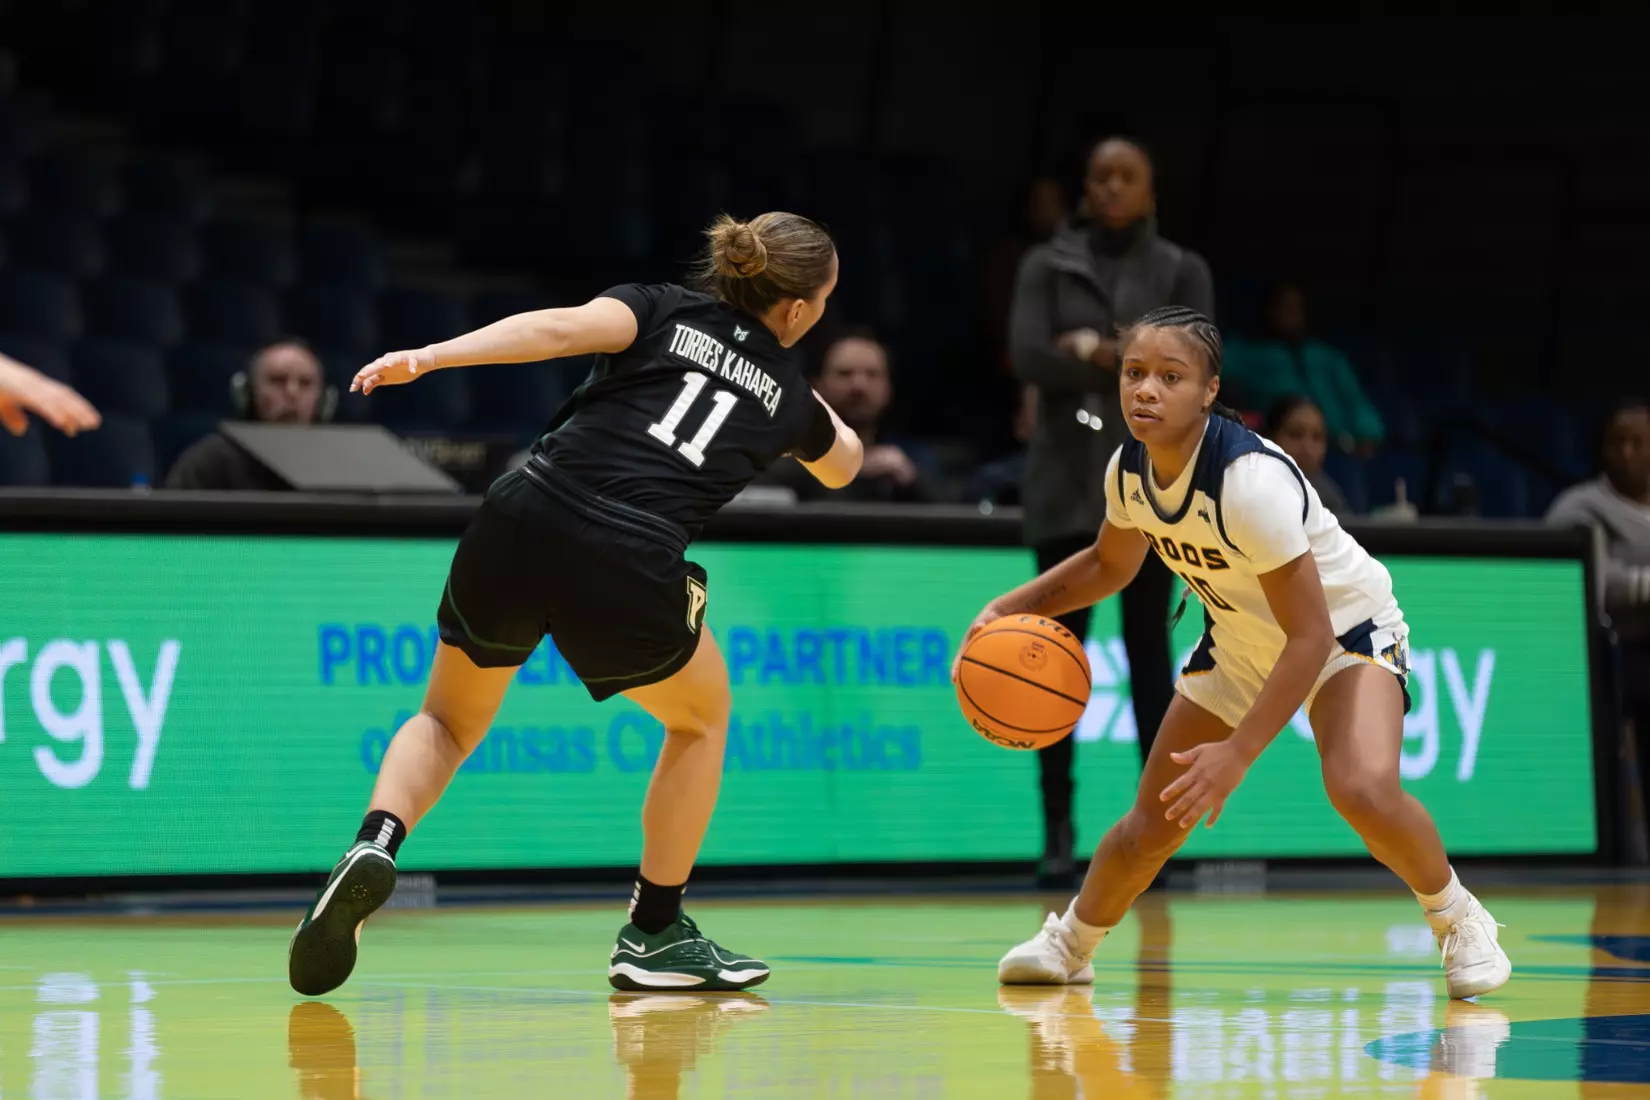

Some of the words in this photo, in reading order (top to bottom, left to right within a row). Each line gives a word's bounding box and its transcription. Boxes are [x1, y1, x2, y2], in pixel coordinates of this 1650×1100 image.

[669, 323, 724, 373] TORRES
[720, 349, 782, 418] KAHAPEA
[647, 371, 738, 468] 11
[728, 625, 951, 687] PARTNER
